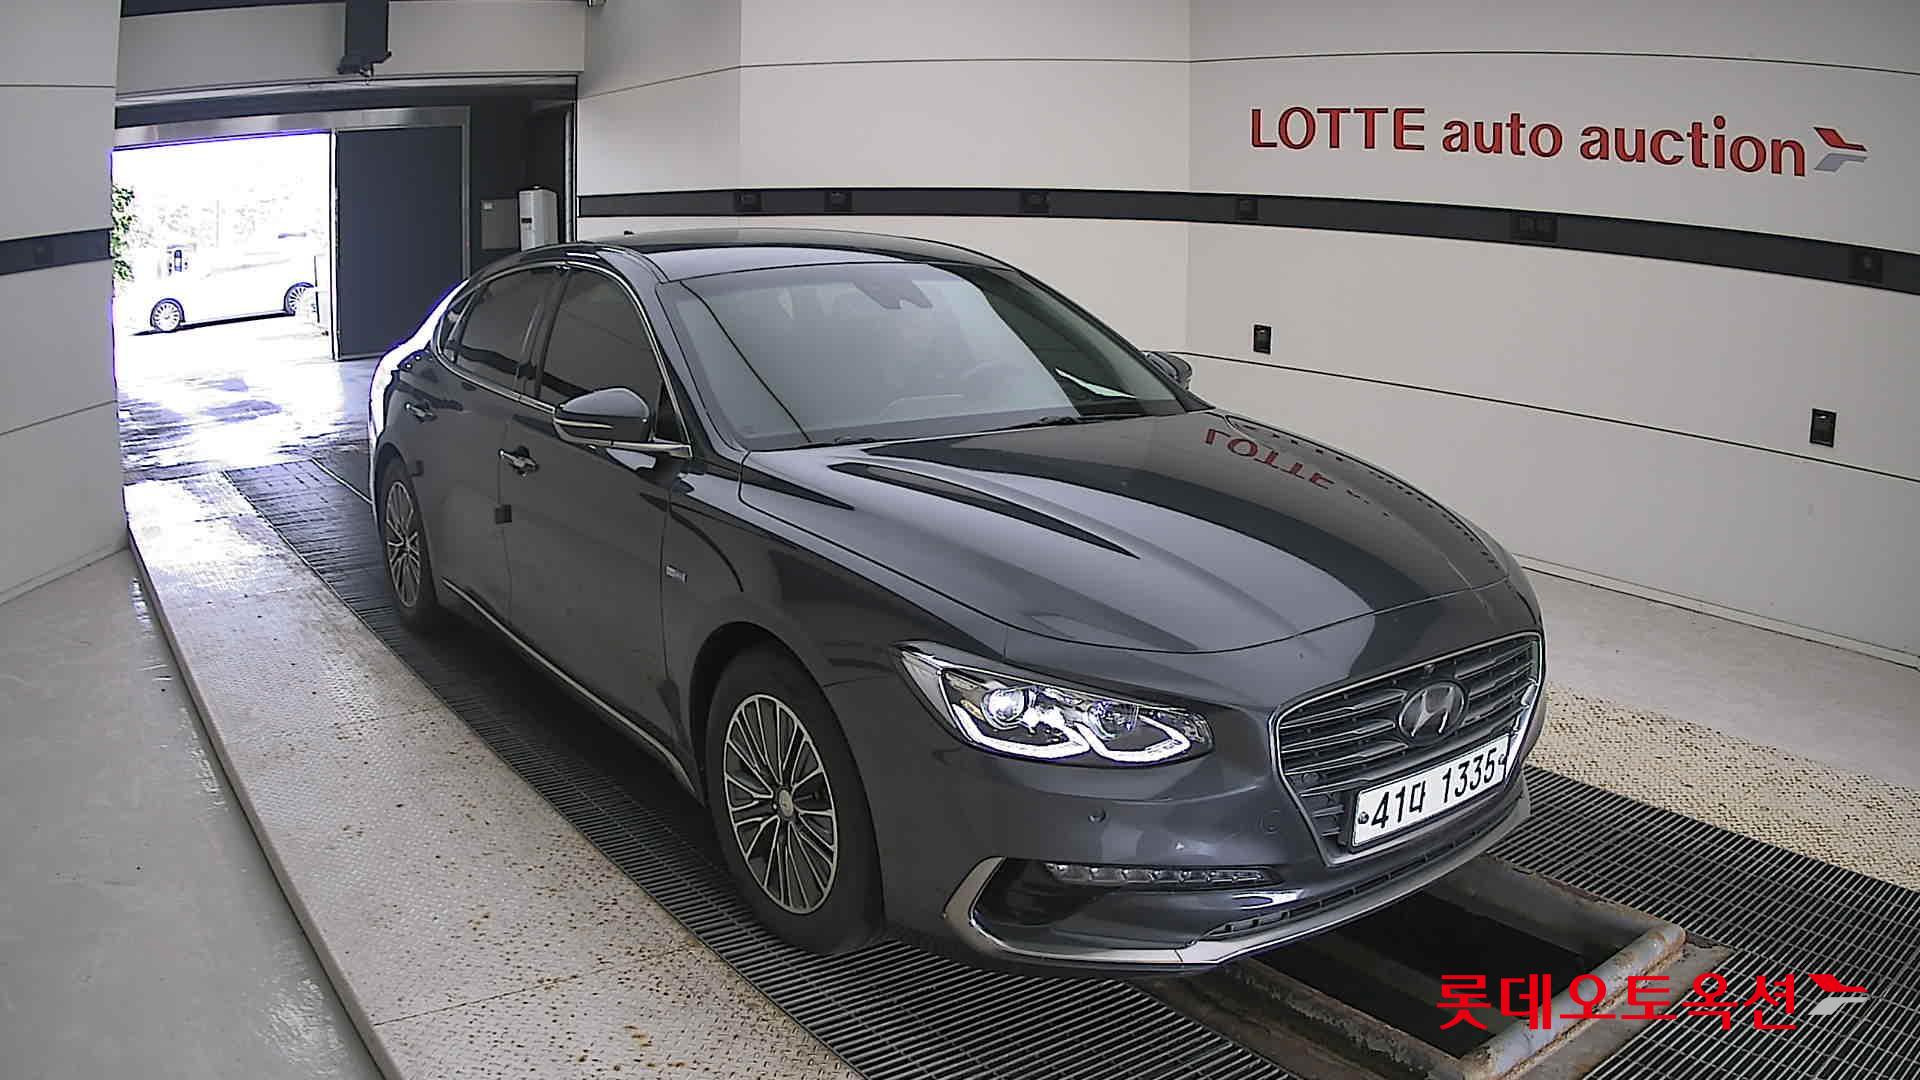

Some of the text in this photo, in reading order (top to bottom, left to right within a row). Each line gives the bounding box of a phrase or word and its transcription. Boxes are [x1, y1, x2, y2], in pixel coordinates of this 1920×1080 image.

[1251, 106, 1806, 177] LOTTE auto auction
[1442, 748, 1498, 803] 1335
